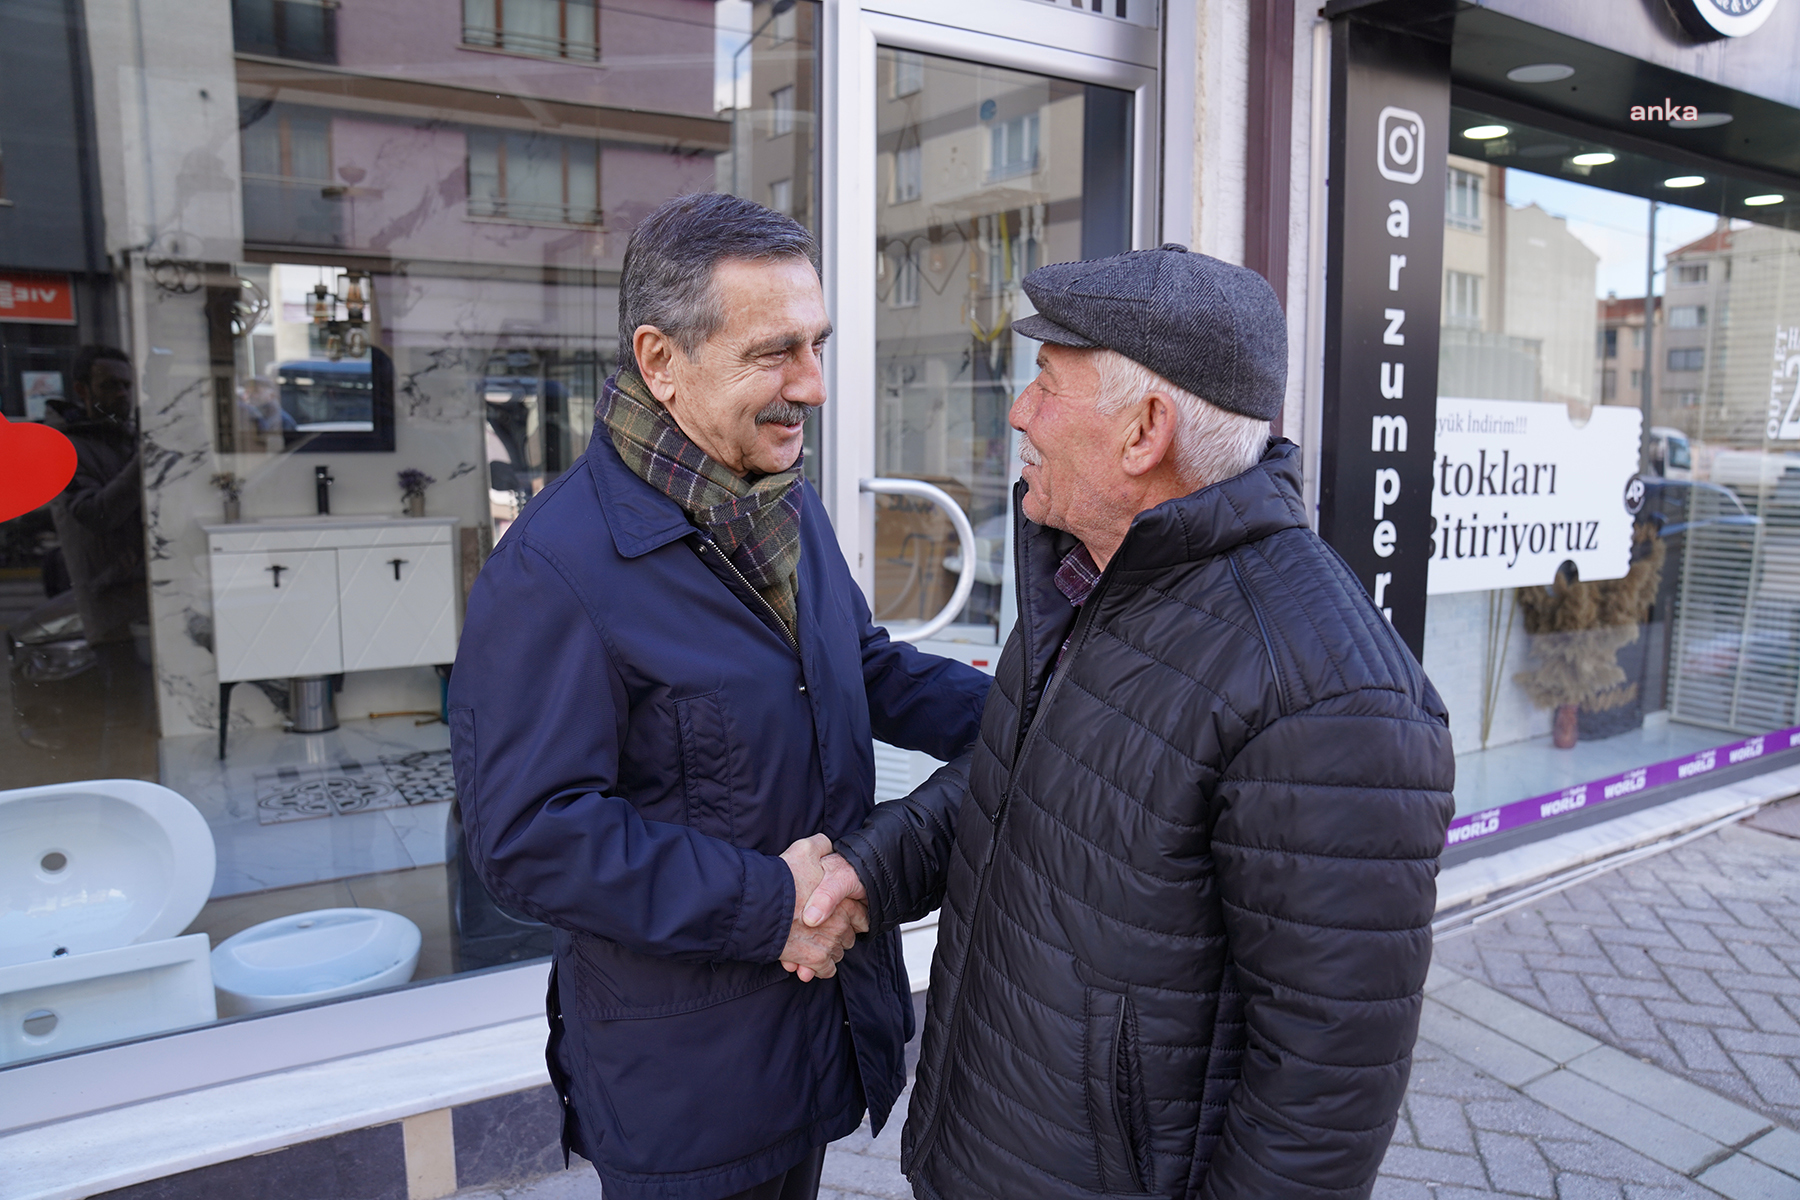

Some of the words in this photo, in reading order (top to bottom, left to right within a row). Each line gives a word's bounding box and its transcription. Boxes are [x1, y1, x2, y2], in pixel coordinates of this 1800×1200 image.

[1767, 325, 1788, 439] OUTLET
[1371, 199, 1410, 623] arzumper
[1435, 413, 1464, 437] yük
[1467, 409, 1528, 435] İndirim!!!
[1433, 449, 1557, 497] tokları
[1729, 743, 1764, 763] WORLD
[1678, 756, 1716, 779] WORLD
[1604, 775, 1647, 799] WORLD
[1540, 793, 1587, 818] WORLD
[1447, 817, 1499, 844] WORLD
